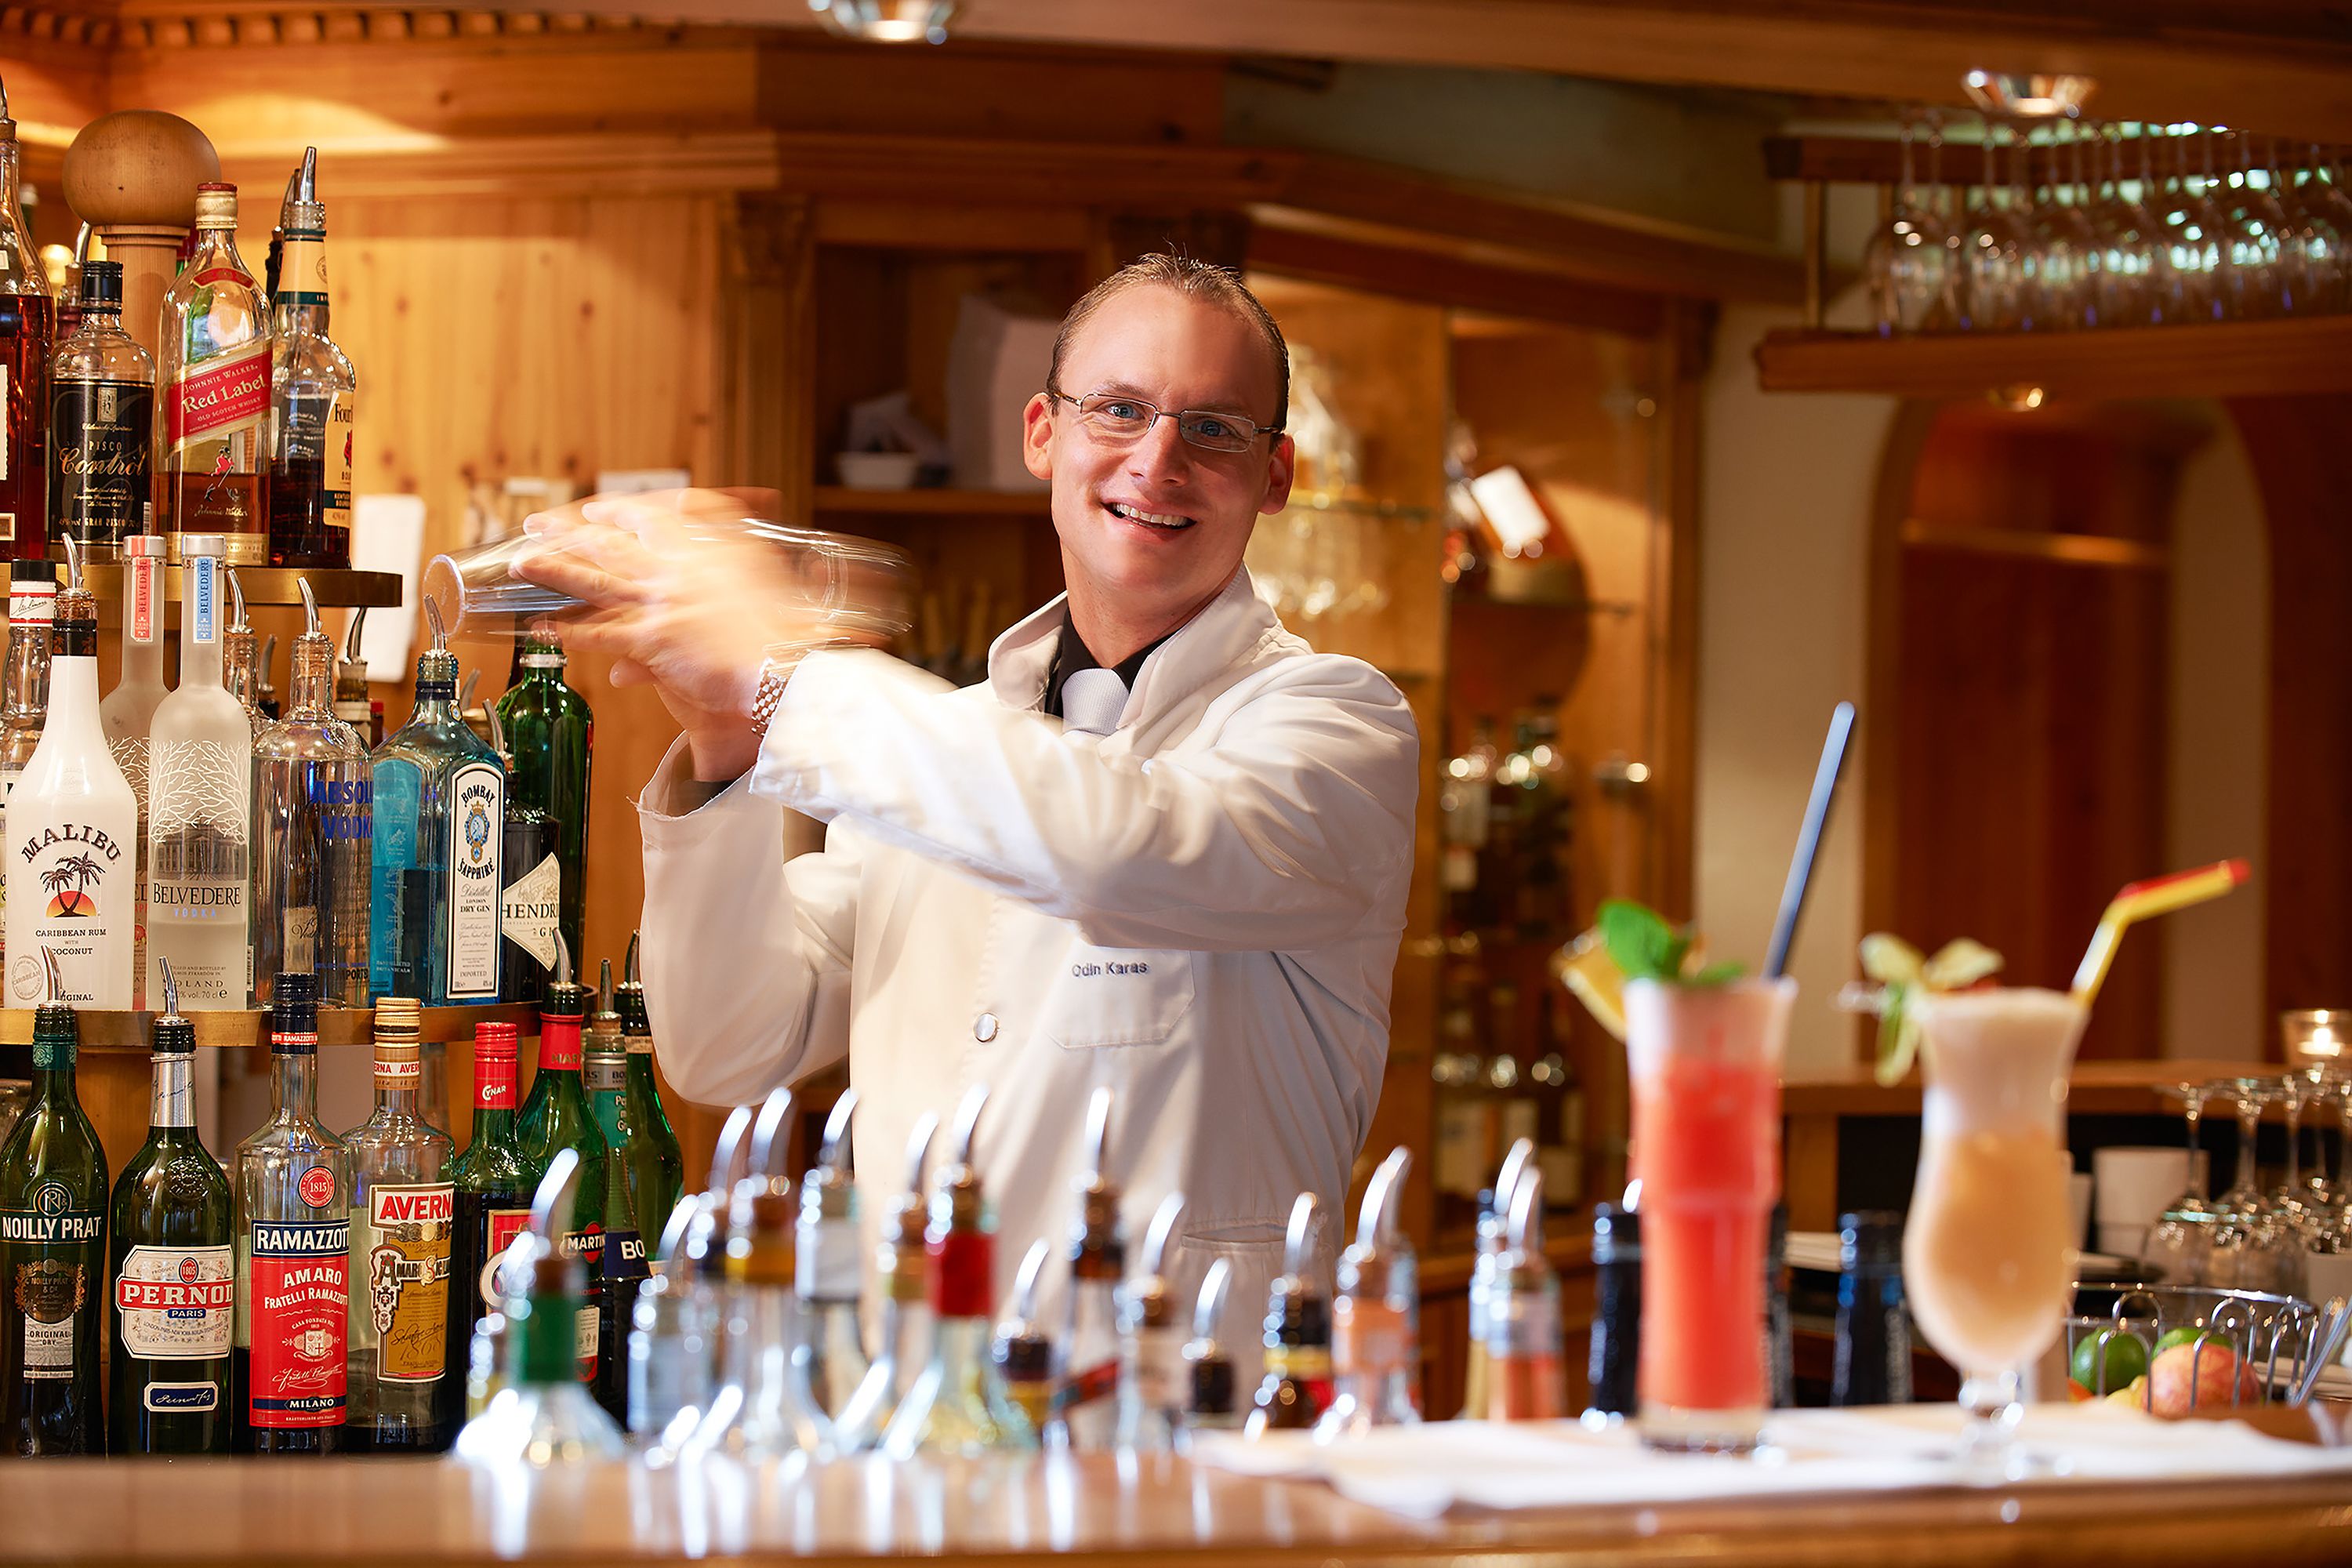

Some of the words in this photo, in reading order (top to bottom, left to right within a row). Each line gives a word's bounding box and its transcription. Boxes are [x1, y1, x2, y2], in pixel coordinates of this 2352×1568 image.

[181, 390, 220, 414] Red
[220, 373, 265, 401] Label
[184, 376, 221, 394] JOHNNIE
[197, 413, 211, 422] OLD
[212, 405, 237, 418] SCOTCH
[238, 396, 262, 408] WHISKY
[89, 441, 122, 452] PISCO
[139, 559, 147, 612] BELVEDERE
[200, 559, 209, 614] BELVEDERE
[461, 784, 495, 808] BOMBAY
[21, 824, 122, 864] MALIBU
[457, 857, 495, 880] SAPPHIRE
[153, 882, 241, 908] BELVEDERE
[460, 883, 493, 897] Distilled
[174, 908, 217, 917] VODKA
[460, 905, 475, 913] DRY
[477, 904, 491, 913] GIN
[35, 929, 86, 938] CARIBBEAN
[1105, 961, 1149, 975] Karas
[482, 1084, 506, 1101] CYNAR
[310, 1181, 327, 1192] 1815
[2, 1217, 57, 1240] NOILLY
[61, 1216, 102, 1239] PRAT
[183, 1266, 196, 1276] 1805
[283, 1267, 343, 1289] AMARO
[123, 1283, 233, 1305] PERNOD
[264, 1290, 306, 1309] FRATELLI
[171, 1309, 204, 1318] PARIS
[289, 1398, 335, 1408] MILANO
